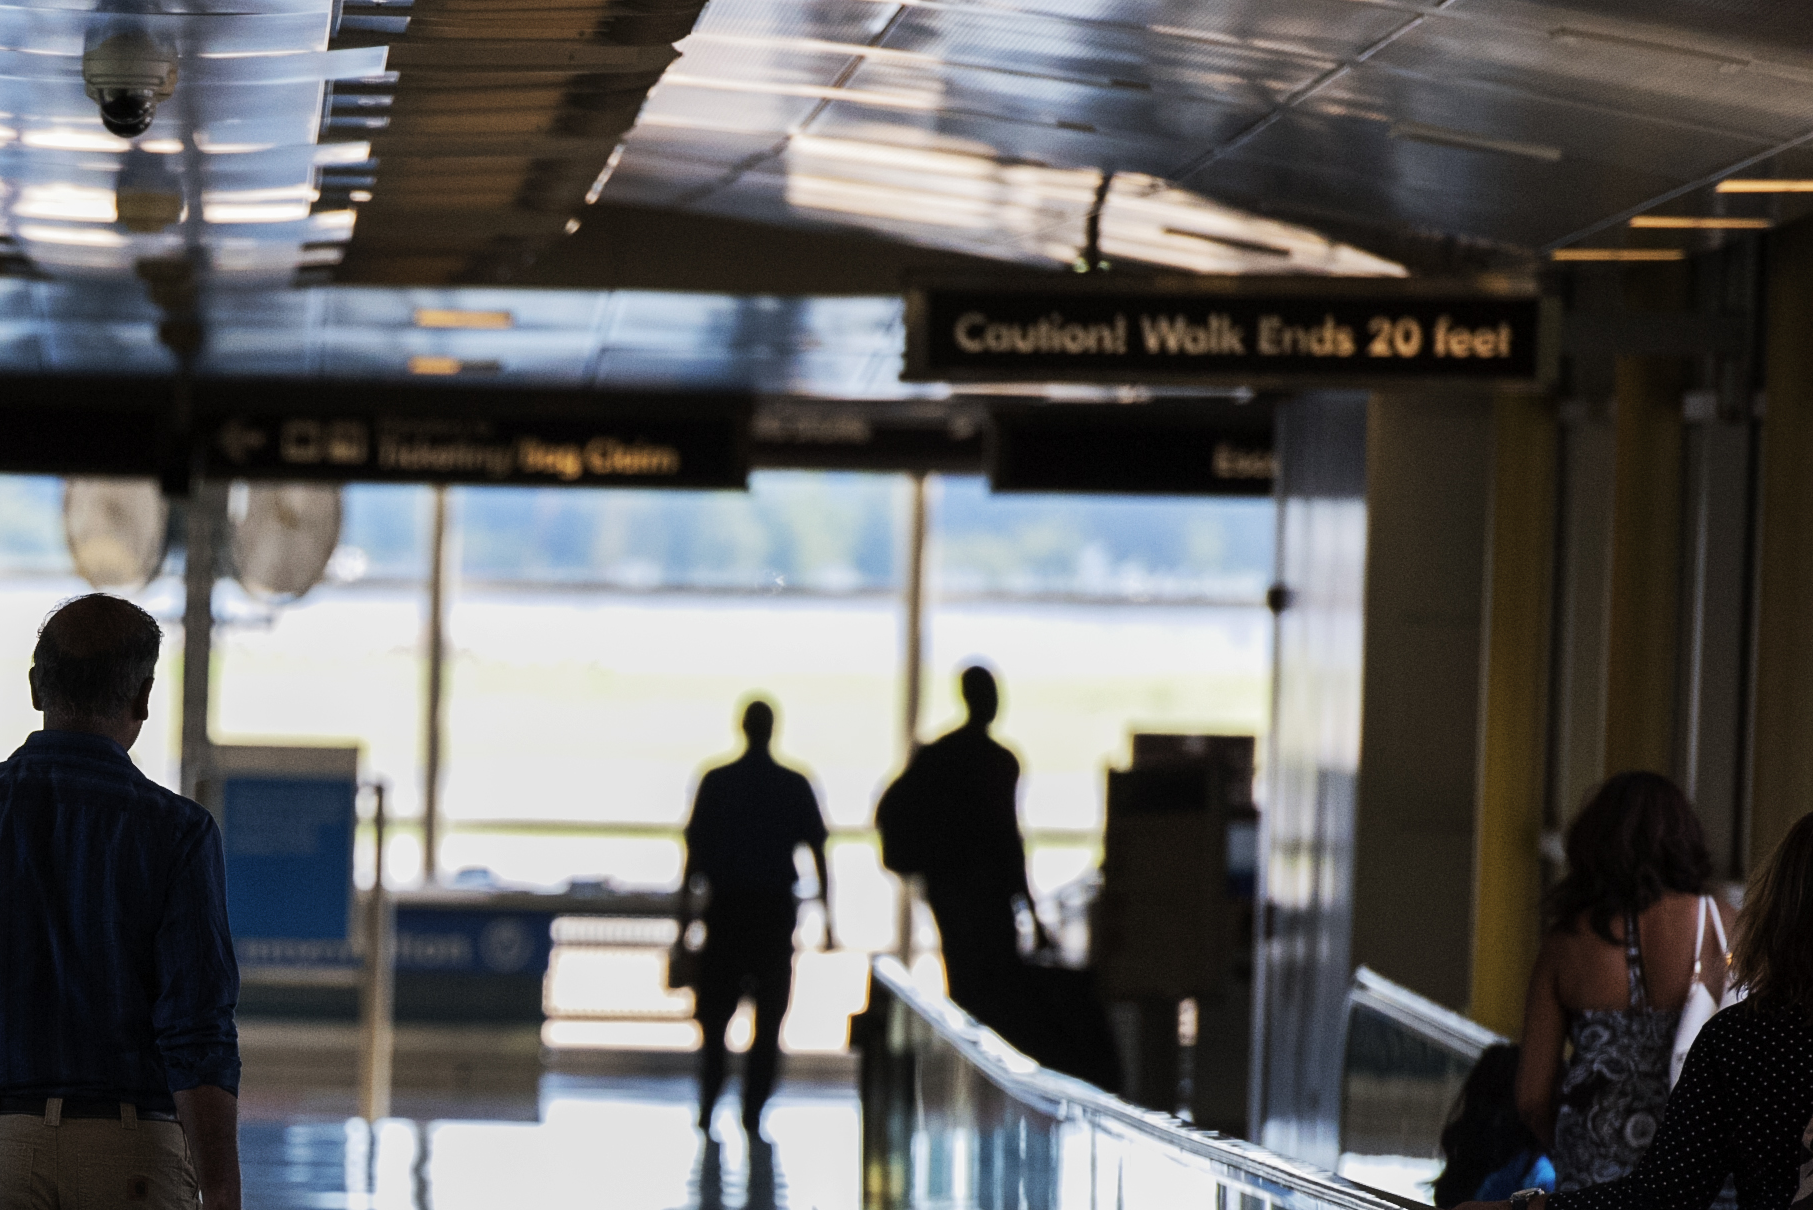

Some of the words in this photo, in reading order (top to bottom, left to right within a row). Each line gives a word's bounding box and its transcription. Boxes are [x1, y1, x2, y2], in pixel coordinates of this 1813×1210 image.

[954, 311, 1128, 354] Caution!
[1140, 312, 1245, 356] Walk
[1257, 313, 1356, 357] Ends
[1365, 314, 1424, 358] 20
[1434, 312, 1512, 358] feet
[587, 436, 681, 475] Claim
